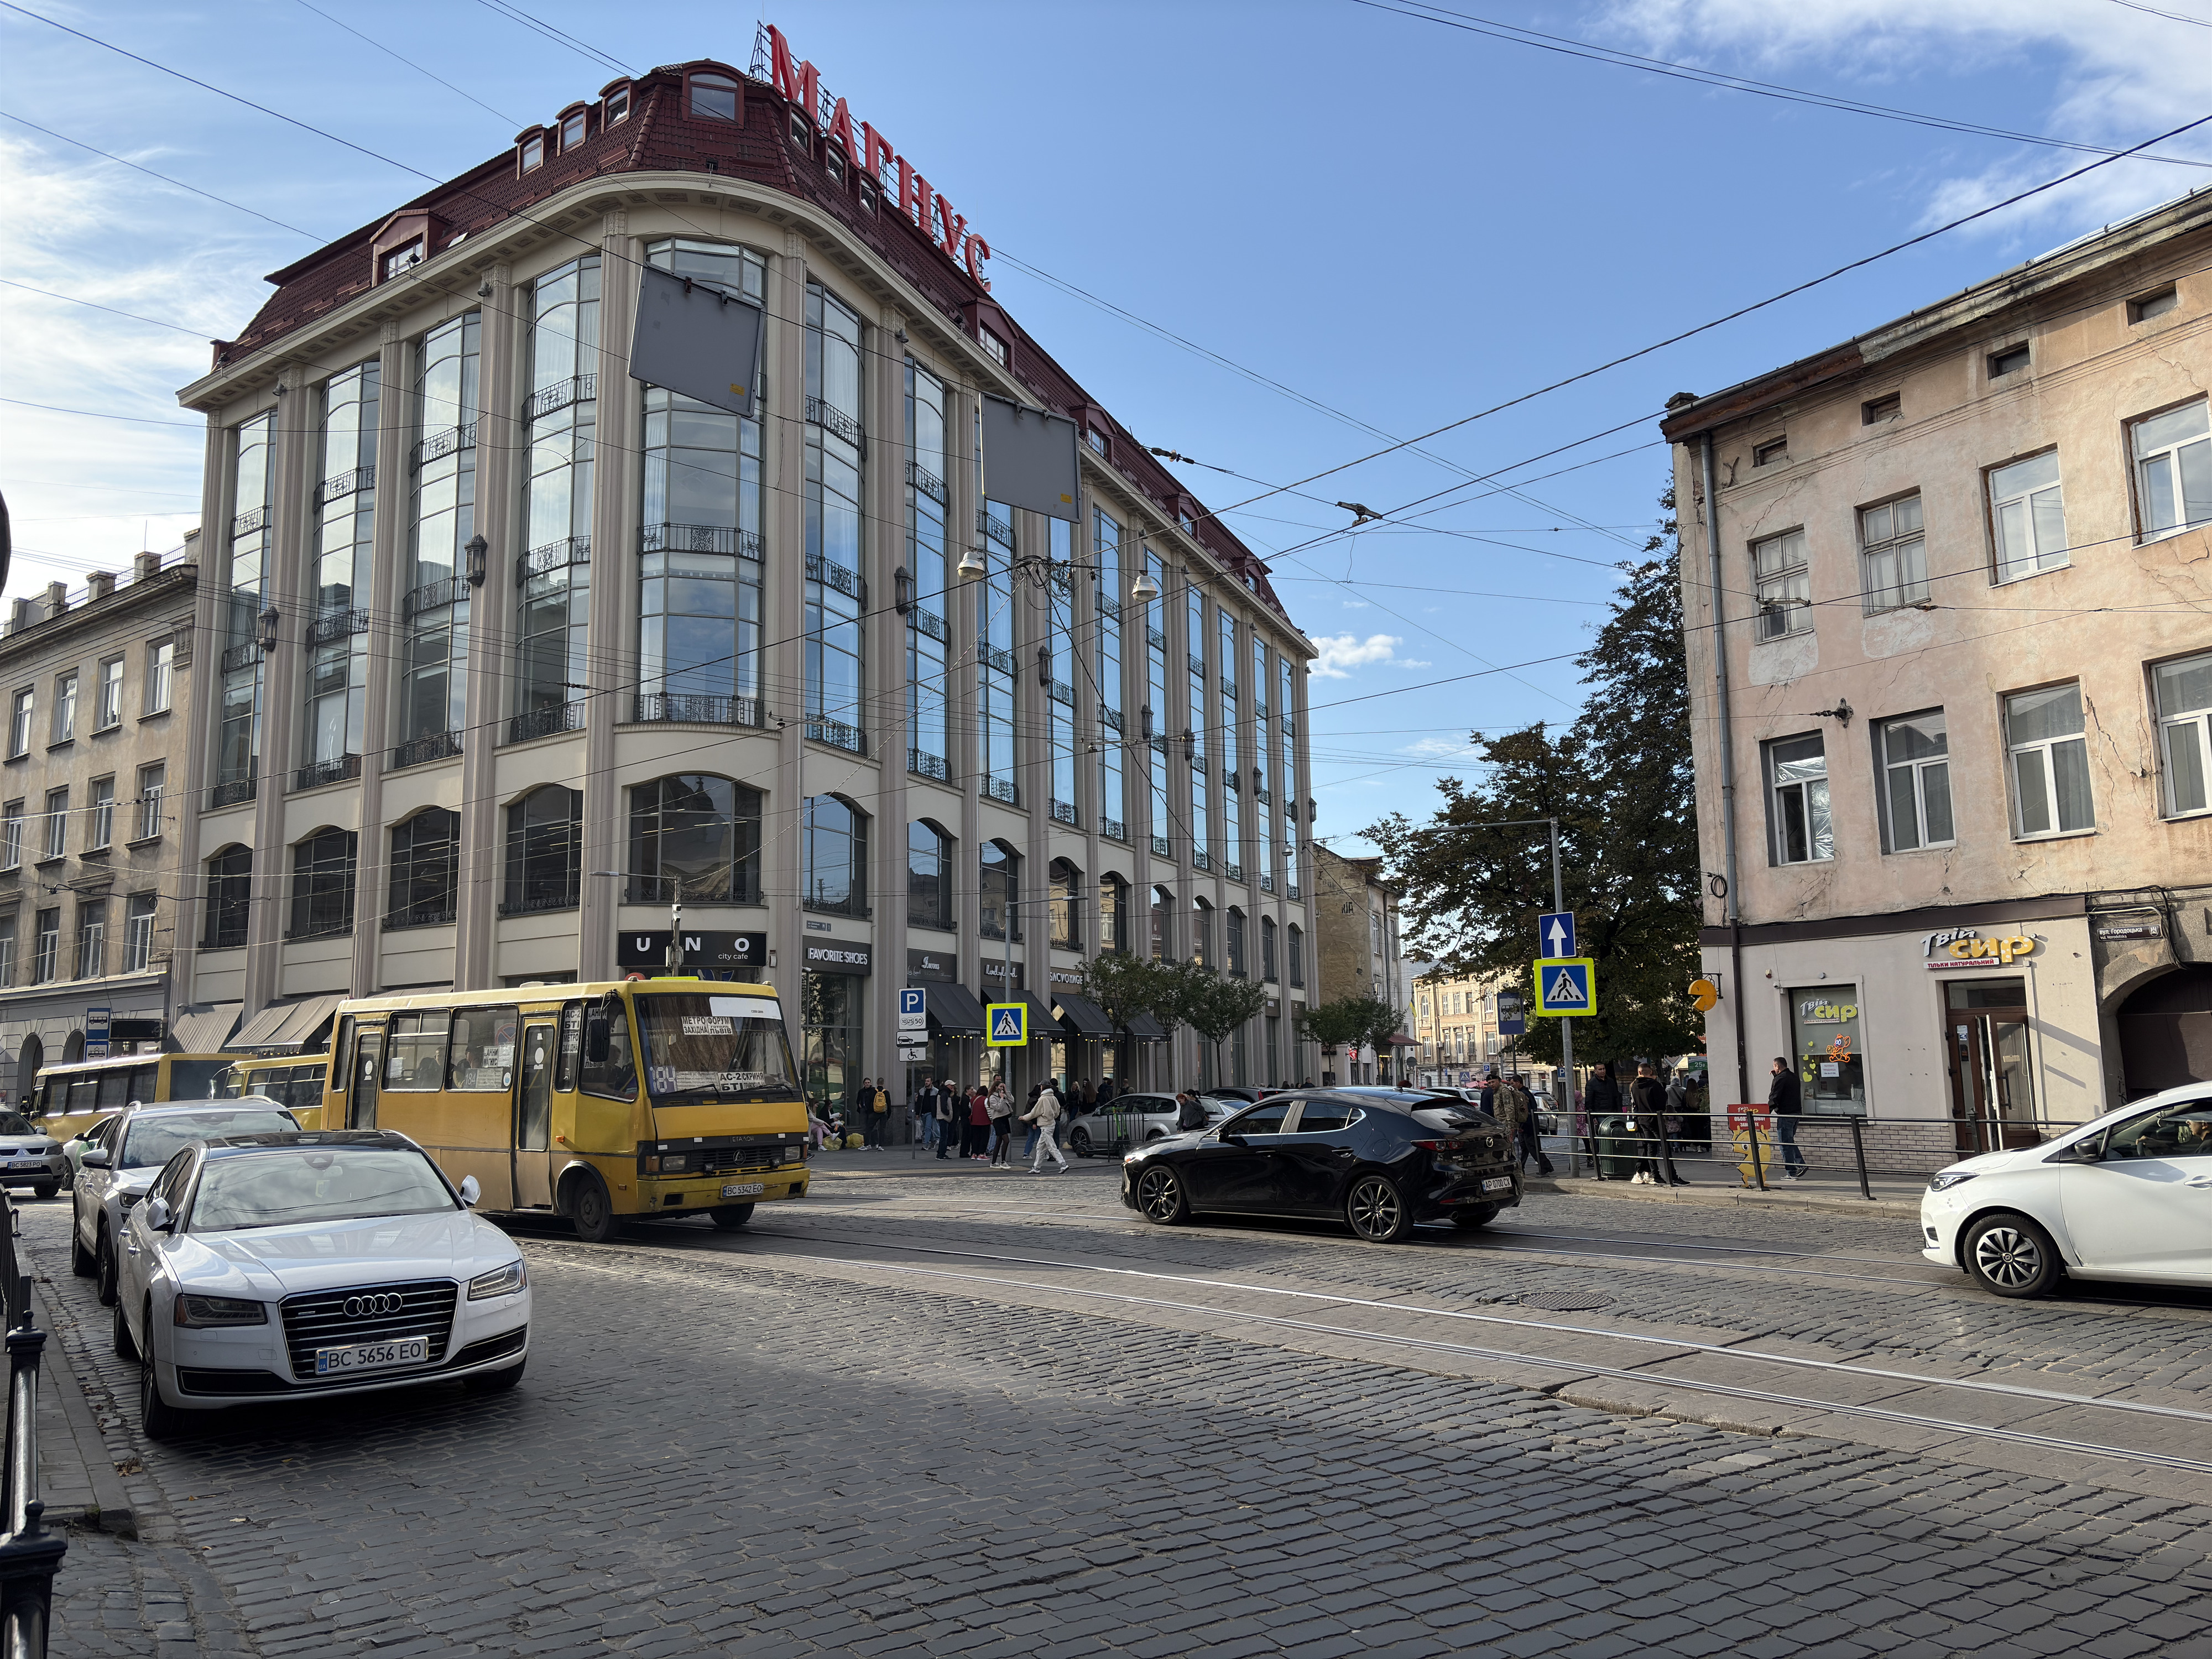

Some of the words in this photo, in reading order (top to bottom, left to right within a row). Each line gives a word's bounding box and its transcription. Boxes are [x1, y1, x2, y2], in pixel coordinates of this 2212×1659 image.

[766, 24, 991, 292] МАГНУС
[1920, 928, 1976, 957] Твій
[807, 947, 843, 963] FAVORITE
[844, 951, 868, 965] SHOES
[1950, 958, 1994, 967] НАТУРАЛЬНИЙ
[1050, 972, 1083, 984] SACVOYAGE
[907, 993, 919, 1011] P
[1800, 999, 1829, 1017] Твій
[565, 1010, 580, 1019] АС-2
[565, 1020, 580, 1029] БТІ
[682, 1016, 706, 1025] МЕТРО
[707, 1016, 729, 1025] ФОРУМ
[684, 1026, 708, 1034] ЗАХІДНА
[564, 1034, 579, 1043] МЕТРО
[562, 1043, 578, 1053] ЗАХІДНА
[466, 1073, 476, 1085] 184
[742, 1072, 764, 1081] СКРИНЯ
[1485, 1181, 1492, 1190] AP
[1493, 1179, 1503, 1188] 0700
[1504, 1177, 1511, 1187] CX
[727, 1187, 737, 1195] BC
[738, 1186, 752, 1194] 5342
[328, 1352, 352, 1368] BC
[357, 1346, 394, 1364] 5656
[400, 1343, 421, 1359] EO
